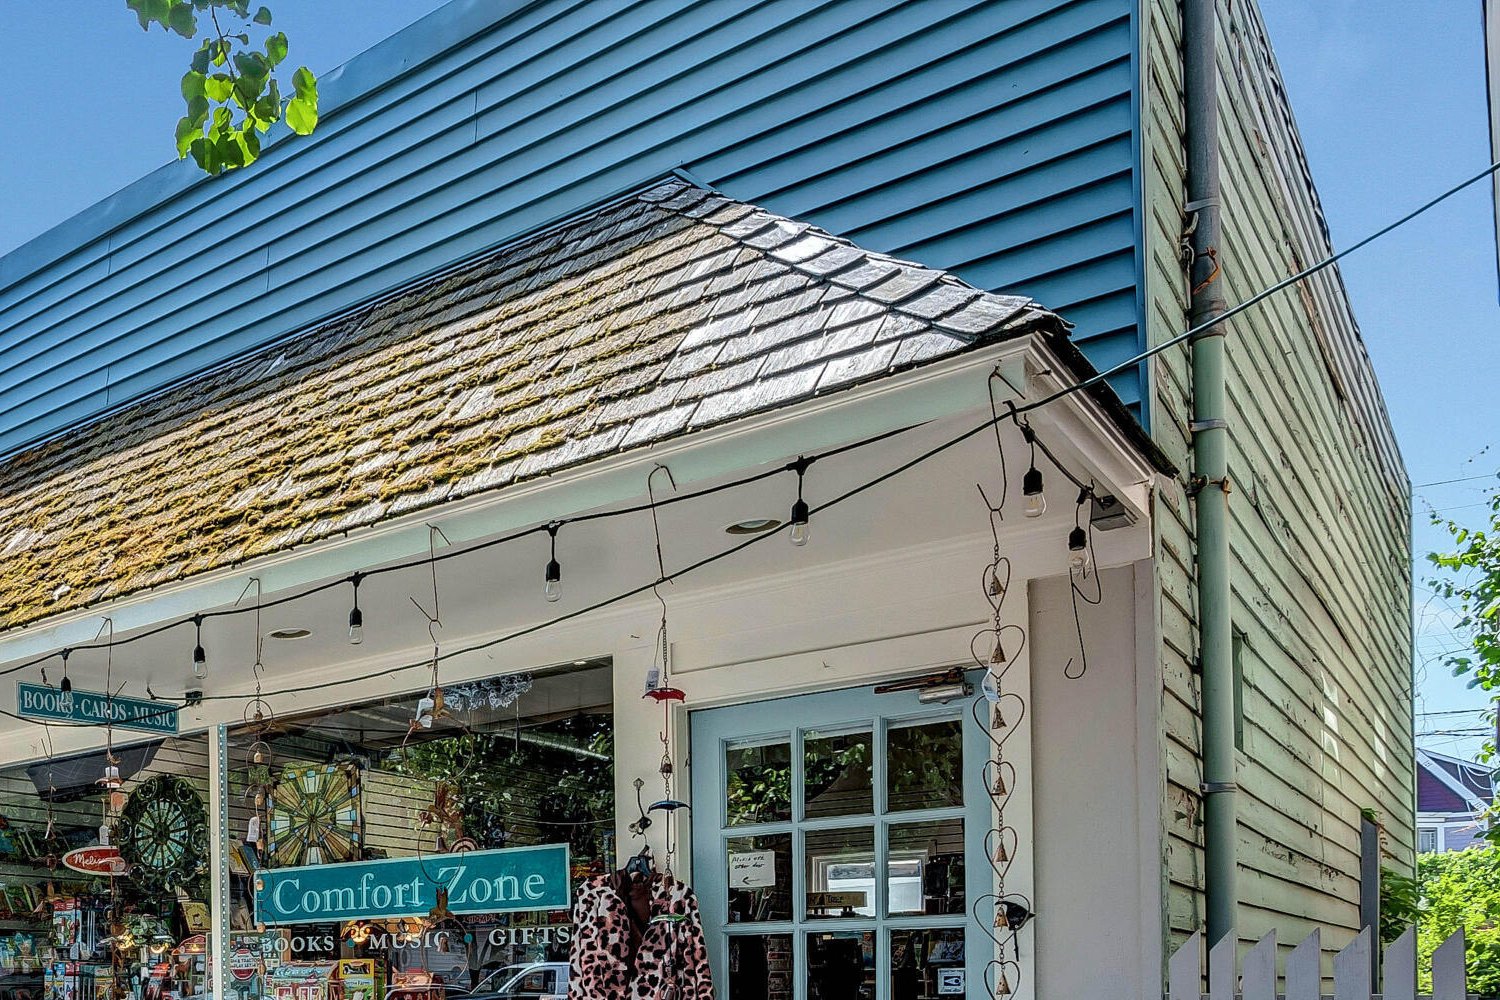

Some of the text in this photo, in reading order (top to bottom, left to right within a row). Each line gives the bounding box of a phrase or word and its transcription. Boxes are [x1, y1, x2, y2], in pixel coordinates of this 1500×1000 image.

[81, 699, 127, 721] CARDS
[133, 705, 175, 728] MUSIC
[273, 866, 546, 915] Comfort Zone
[260, 926, 572, 953] BOOKS MUSIC GIFTS
